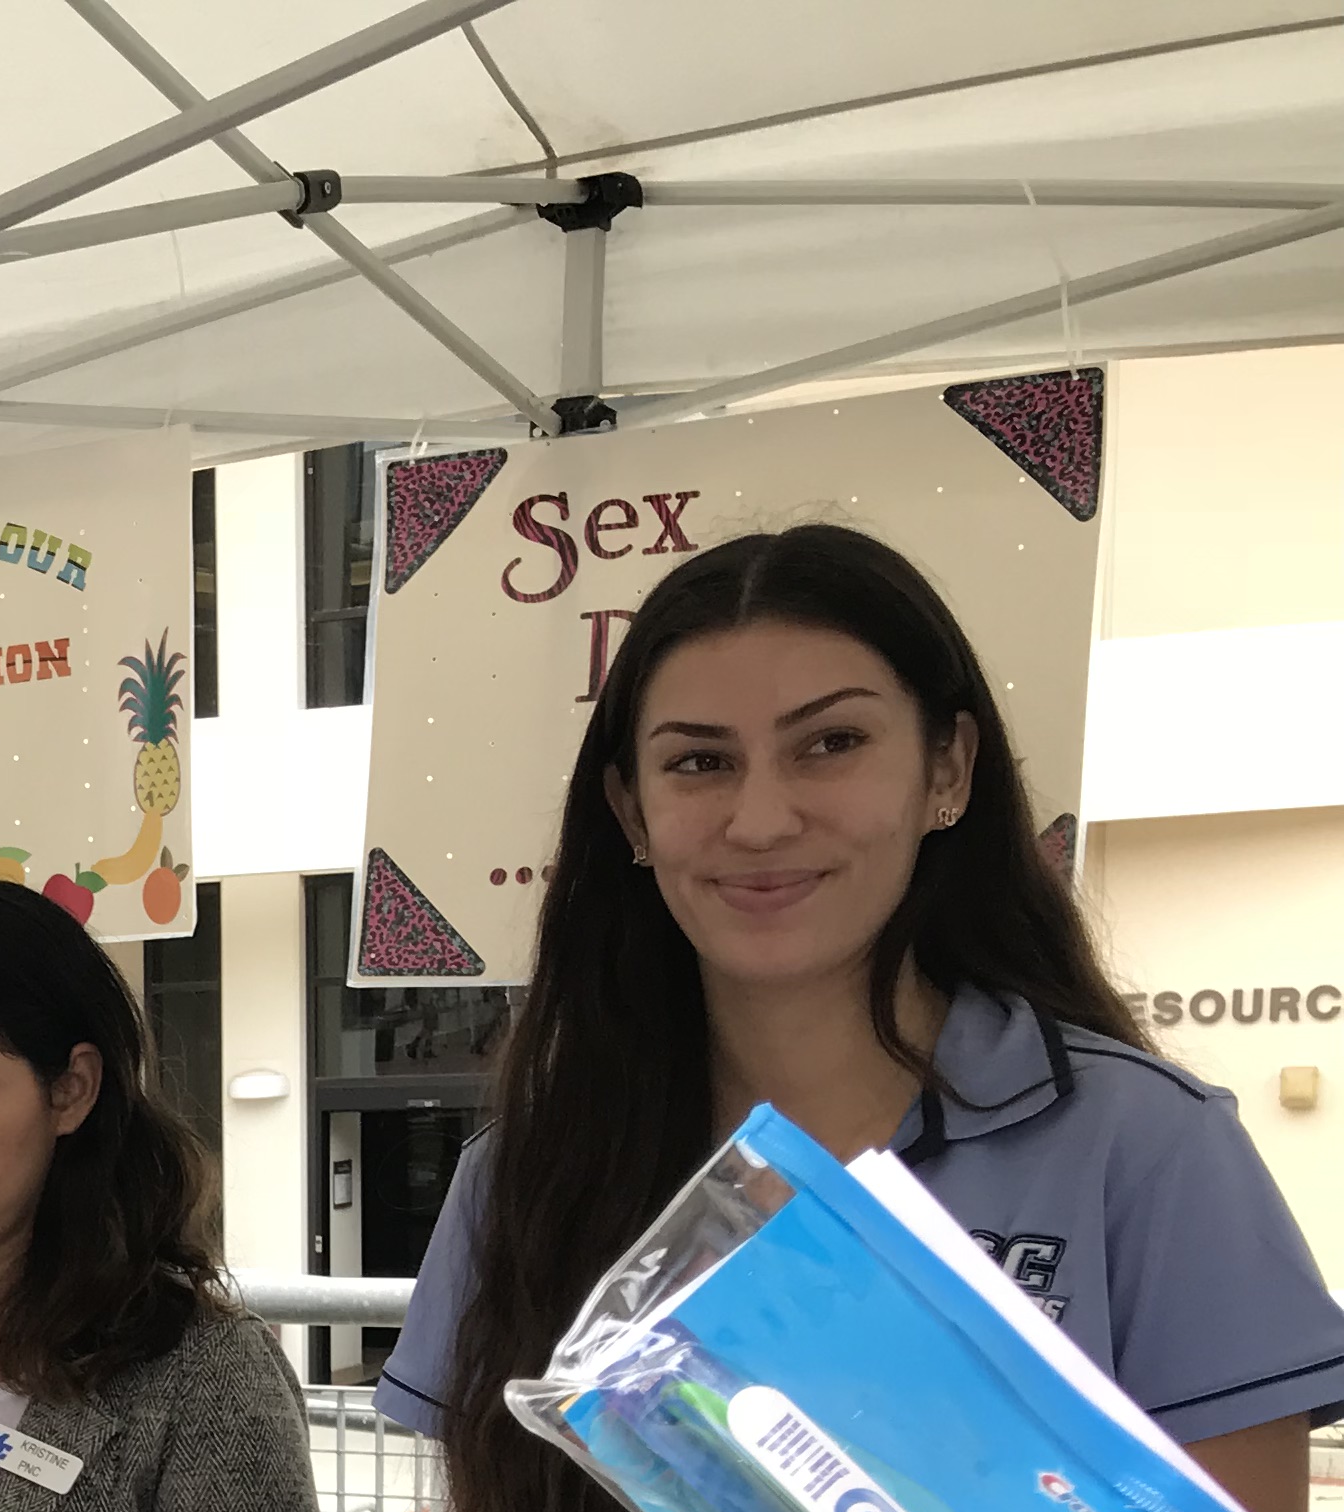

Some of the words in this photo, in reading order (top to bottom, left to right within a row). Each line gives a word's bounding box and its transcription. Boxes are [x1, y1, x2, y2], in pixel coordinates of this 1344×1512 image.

[500, 490, 701, 604] Sex
[17, 1459, 42, 1478] PNC
[20, 1439, 70, 1471] KRISTINE
